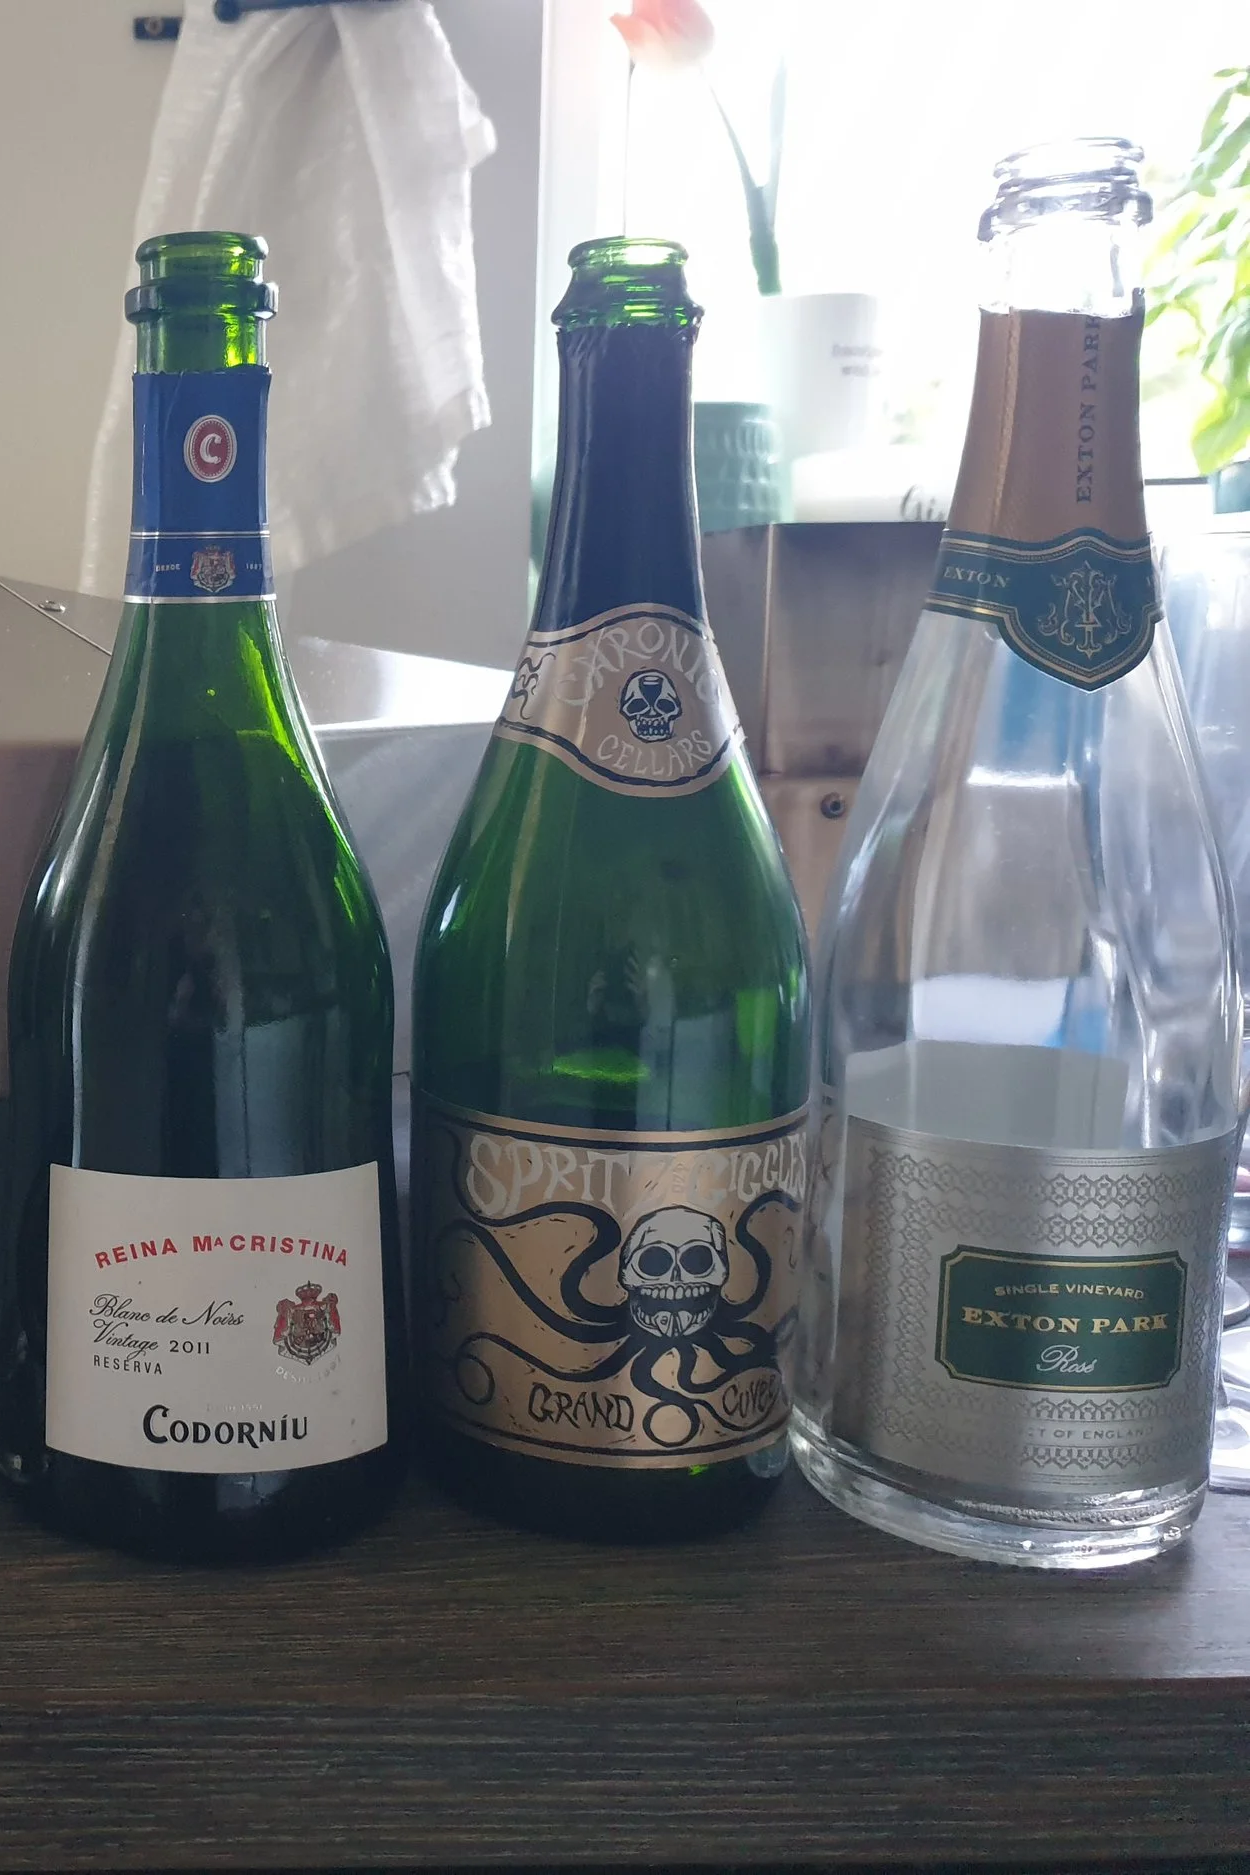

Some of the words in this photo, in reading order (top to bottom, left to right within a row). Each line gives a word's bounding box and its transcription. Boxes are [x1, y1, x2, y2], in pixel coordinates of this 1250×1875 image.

[199, 432, 222, 465] C
[1076, 403, 1097, 504] EXTON
[943, 566, 1010, 589] EXTON
[596, 729, 712, 777] CELLARS
[94, 1237, 178, 1270] REINA
[229, 1234, 349, 1267] CRISTINA
[994, 1283, 1059, 1297] SINGLE
[1065, 1283, 1145, 1300] VINEYARD
[89, 1293, 151, 1325] Blanc
[155, 1308, 178, 1326] de
[182, 1300, 244, 1327] Noirs
[961, 1305, 1080, 1334] EXTON
[1091, 1312, 1169, 1334] PARK
[93, 1319, 159, 1362] Vintage
[169, 1340, 211, 1355] 2011
[94, 1354, 163, 1375] RESERVA
[1036, 1344, 1097, 1374] Rosé
[527, 1381, 635, 1432] GRAND
[143, 1403, 308, 1449] CODORNÍU
[1053, 1428, 1075, 1439] OF
